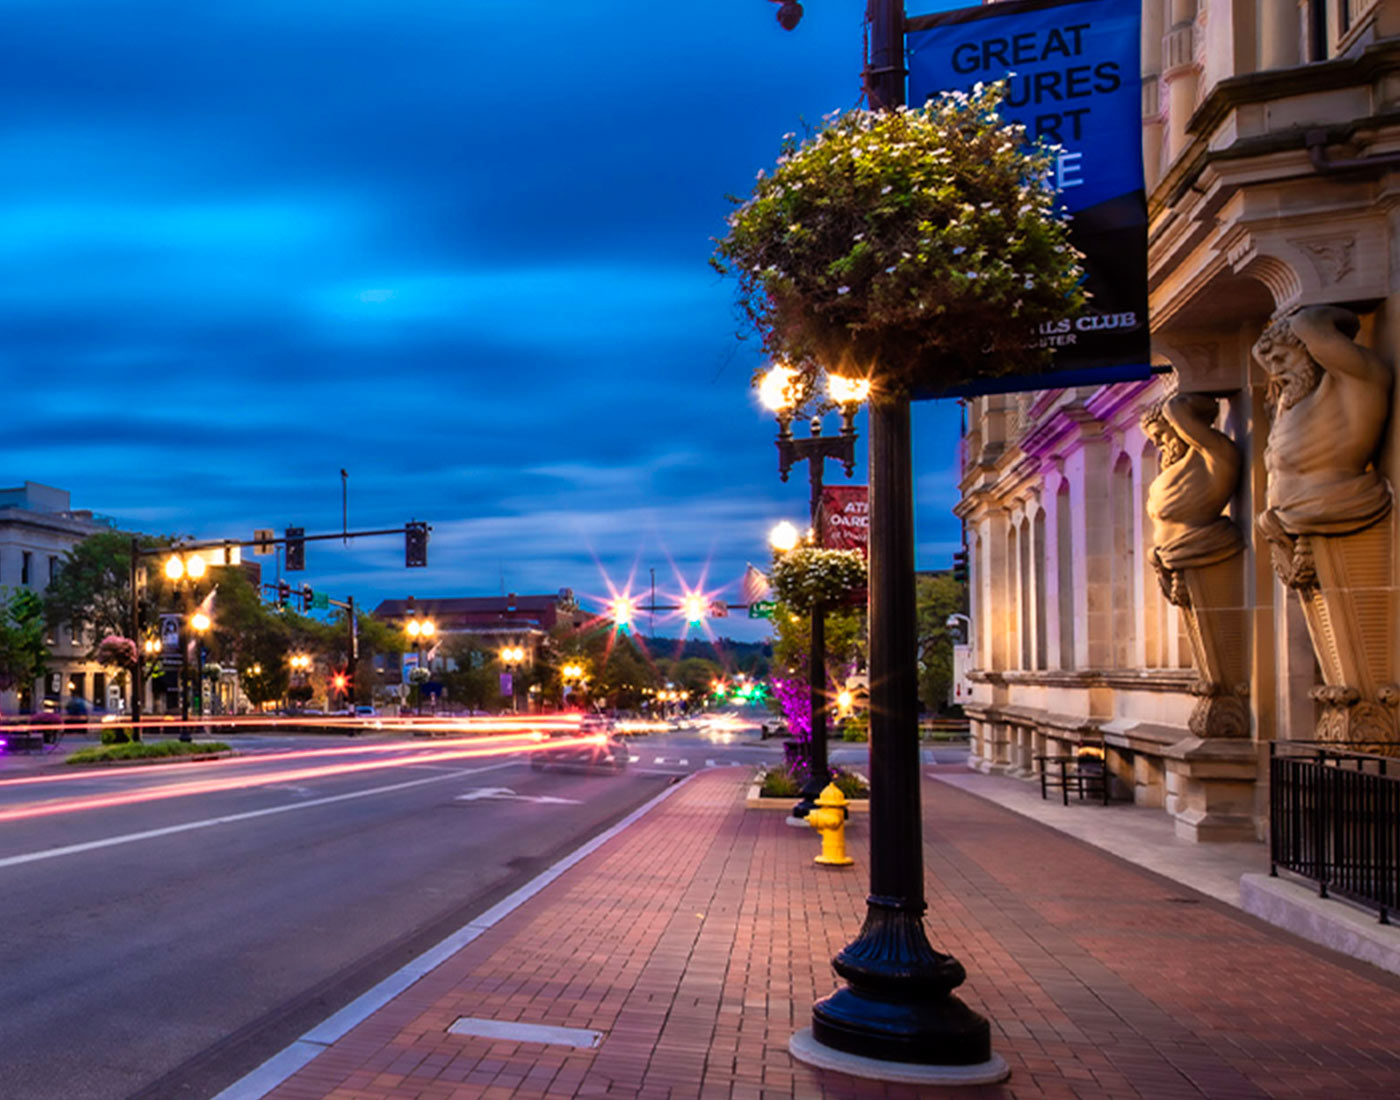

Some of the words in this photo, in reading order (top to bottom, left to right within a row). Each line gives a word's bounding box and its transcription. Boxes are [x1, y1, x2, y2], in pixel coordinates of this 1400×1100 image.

[951, 23, 1091, 74] GREAT
[970, 61, 1121, 108] URES
[1075, 312, 1137, 331] CLUB
